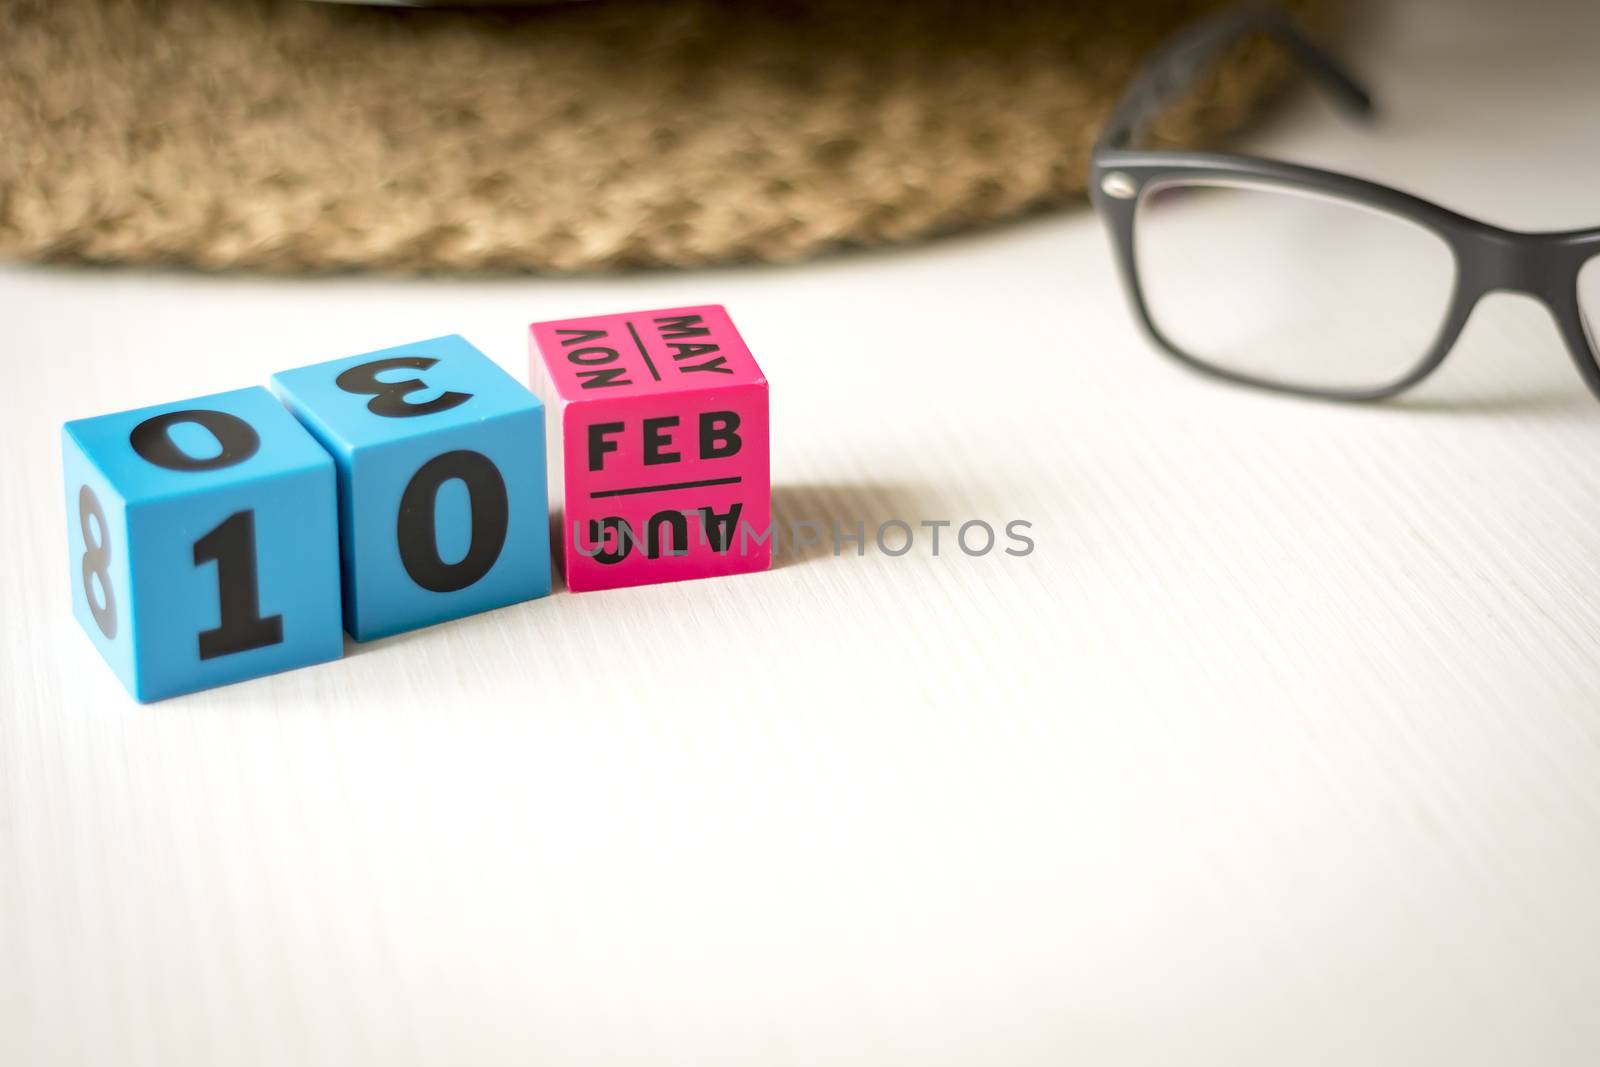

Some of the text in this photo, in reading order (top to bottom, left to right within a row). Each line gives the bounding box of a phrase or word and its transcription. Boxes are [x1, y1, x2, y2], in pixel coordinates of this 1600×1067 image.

[555, 329, 633, 390] NOV
[653, 314, 734, 375] MAY
[129, 409, 261, 472] 0
[587, 410, 742, 472] FEB
[79, 484, 117, 640] 8
[589, 503, 743, 565] AUG
